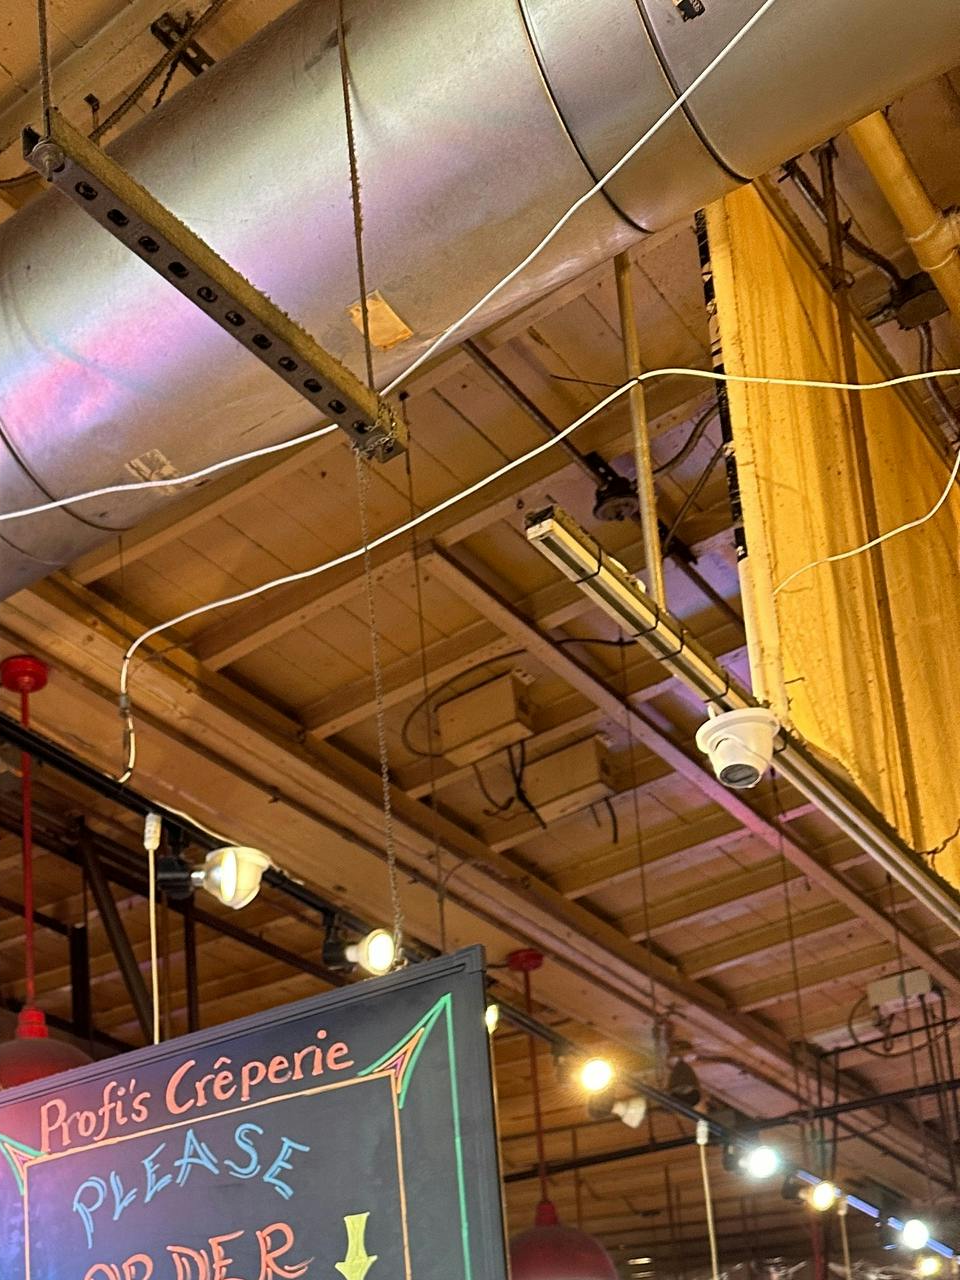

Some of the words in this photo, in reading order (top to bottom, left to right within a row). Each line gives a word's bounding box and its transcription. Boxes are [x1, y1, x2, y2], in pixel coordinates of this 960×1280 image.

[40, 1078, 150, 1153] Profi's
[165, 1030, 355, 1113] Crêperie
[72, 1122, 310, 1249] PLEASE
